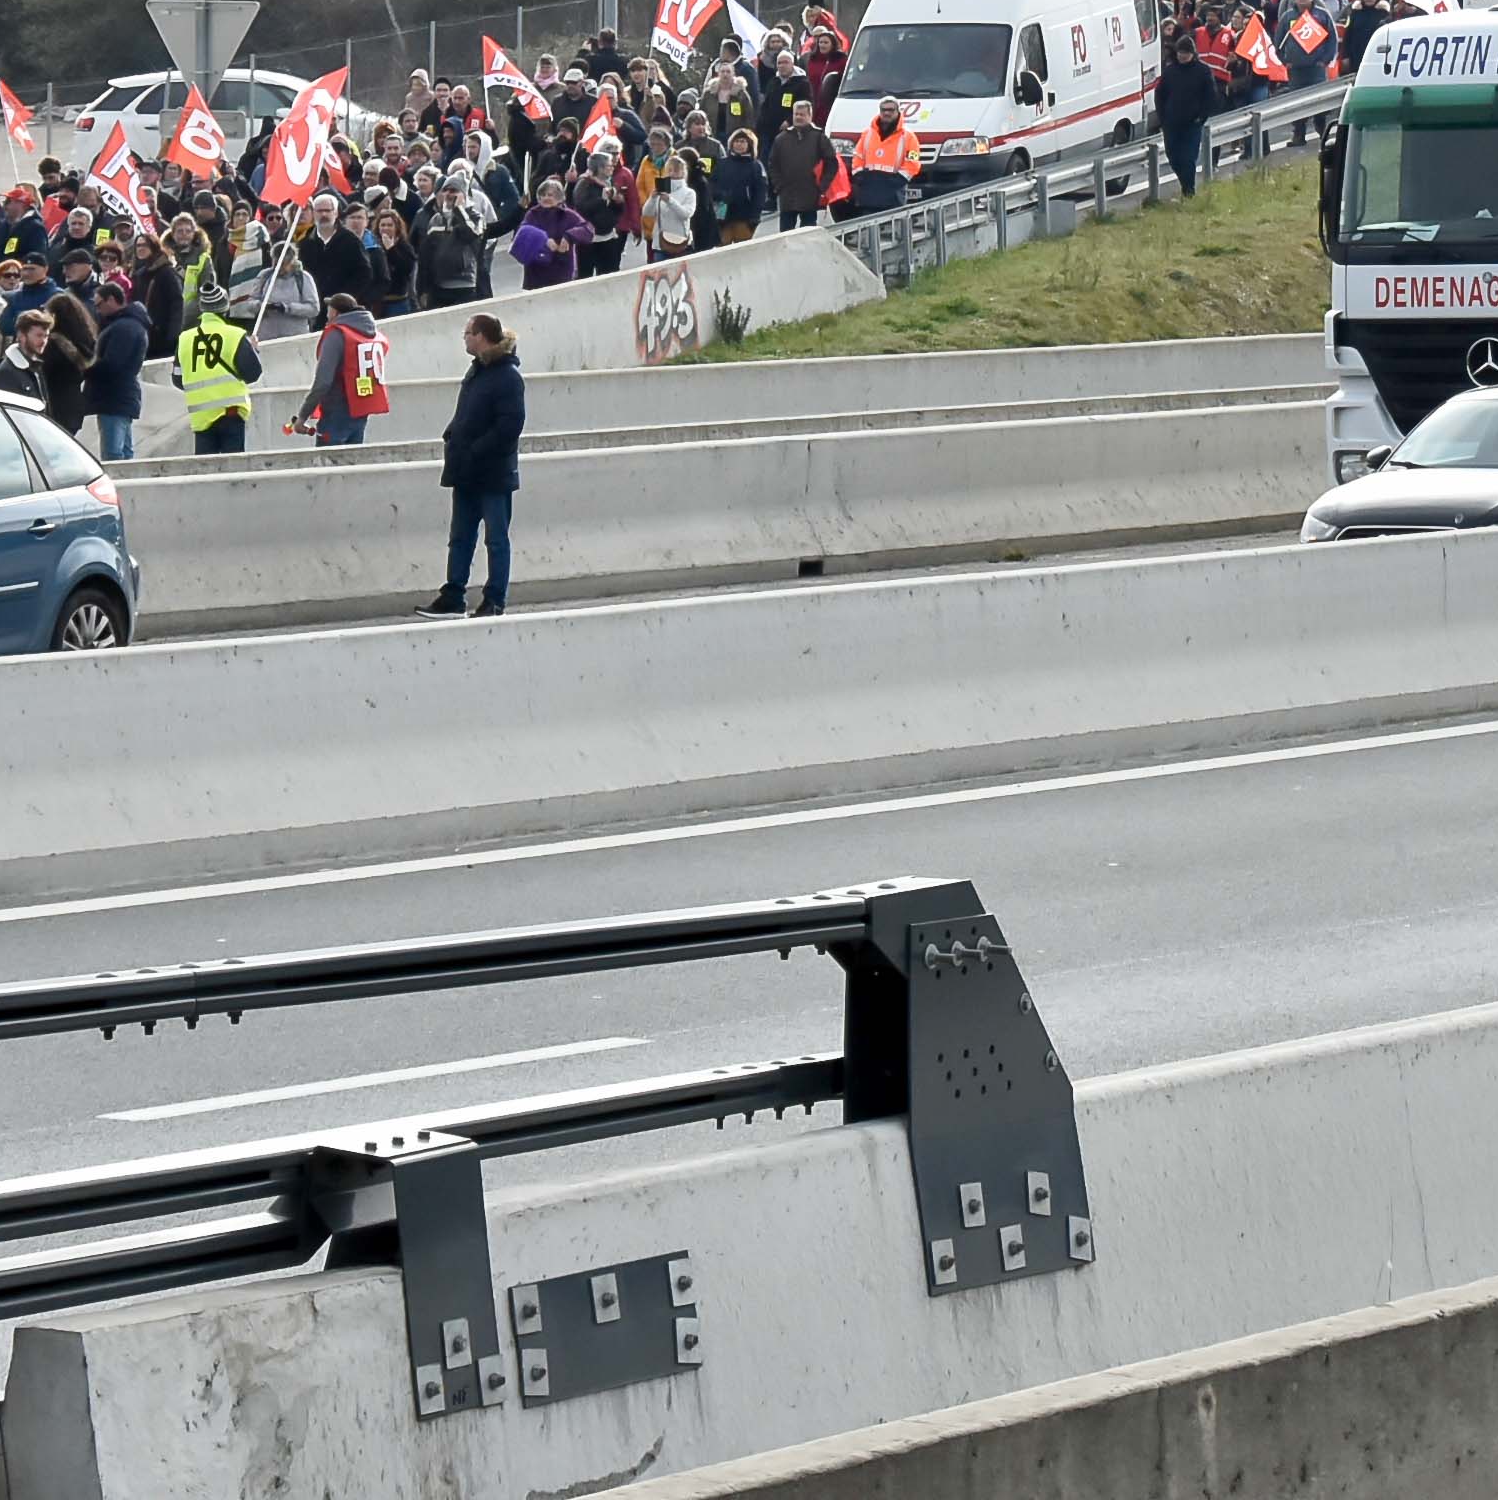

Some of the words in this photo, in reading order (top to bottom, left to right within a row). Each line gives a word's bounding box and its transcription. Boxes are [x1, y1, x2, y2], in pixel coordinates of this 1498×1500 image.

[1070, 23, 1087, 66] FO
[1394, 35, 1492, 78] FORTIN
[191, 333, 223, 372] FO
[358, 342, 385, 385] FO
